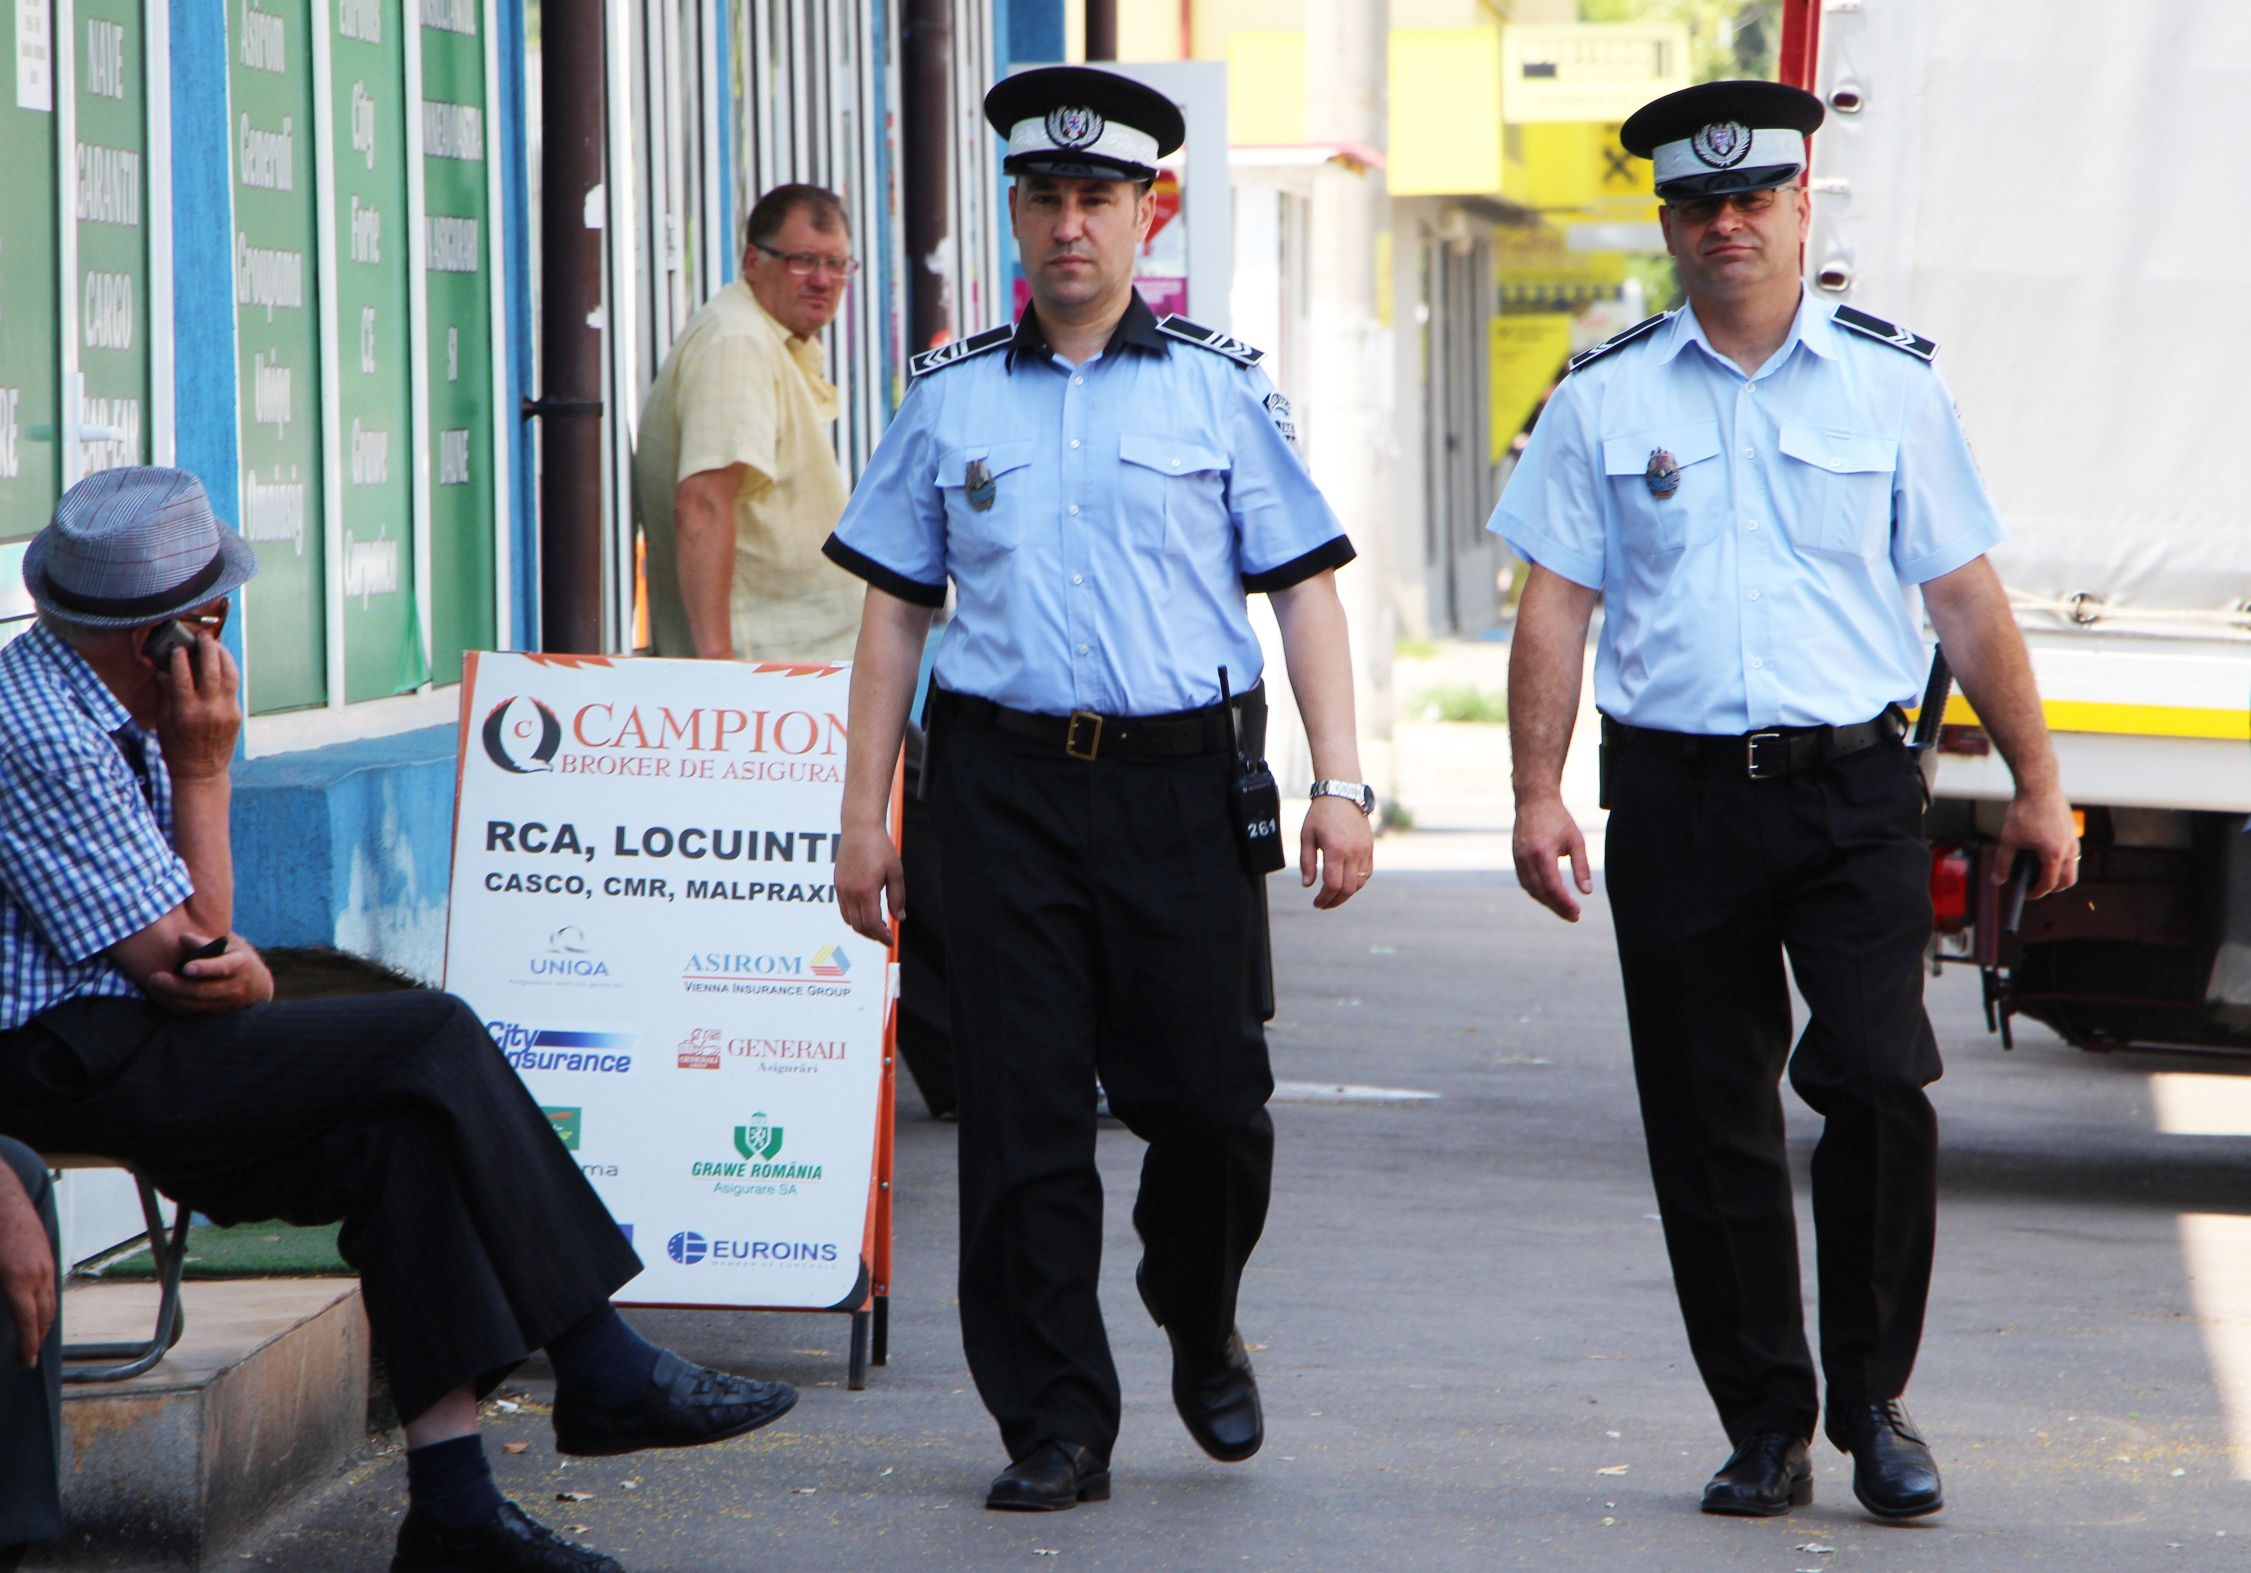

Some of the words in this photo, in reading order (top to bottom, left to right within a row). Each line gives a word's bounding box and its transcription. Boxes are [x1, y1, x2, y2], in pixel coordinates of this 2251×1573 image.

[88, 19, 124, 100] NAVE
[240, 112, 293, 191] Generali
[85, 269, 133, 349] CARGO
[573, 701, 849, 756] CAMPION
[561, 754, 671, 778] BROKER
[678, 759, 715, 780] DE
[722, 760, 846, 784] ASIGURA
[486, 820, 596, 863] RCA,
[485, 872, 593, 900] CASCO,
[604, 876, 676, 903] CMR,
[530, 958, 609, 977] UNIQA
[684, 952, 802, 975] ASIROM
[507, 1049, 632, 1073] nsurance
[727, 1037, 849, 1061] GENERALI
[691, 1160, 748, 1178] GRAWE
[750, 1160, 823, 1180] ROMÂNIA
[712, 1182, 776, 1197] Asigurare
[779, 1183, 799, 1196] SA
[713, 1240, 838, 1262] EUROINS
